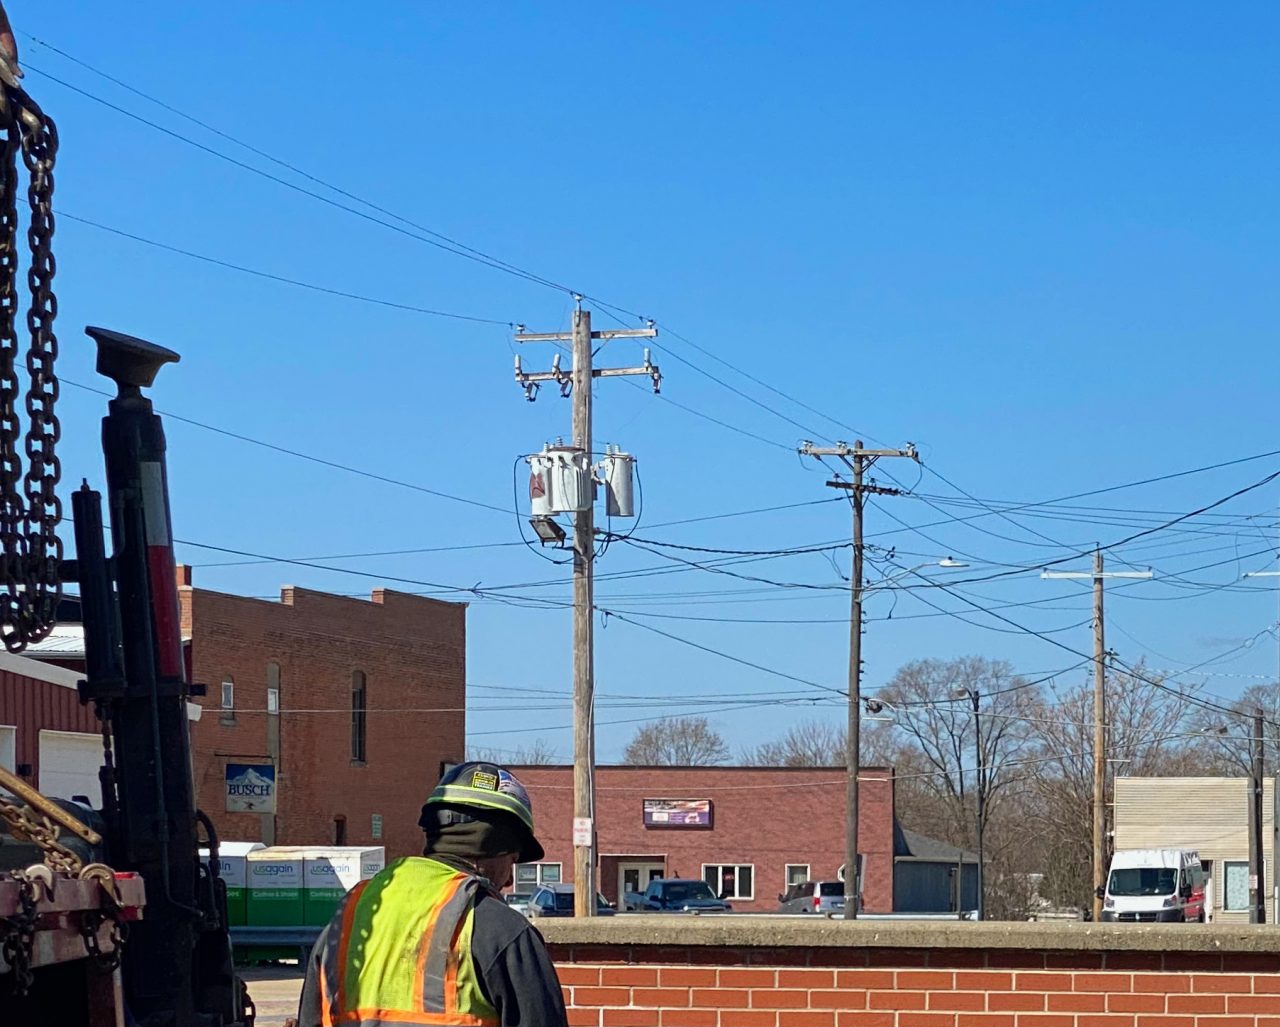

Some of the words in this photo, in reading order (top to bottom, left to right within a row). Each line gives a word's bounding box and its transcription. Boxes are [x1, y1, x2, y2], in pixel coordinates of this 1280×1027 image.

[229, 784, 271, 796] BUSCH
[253, 864, 293, 876] usagain
[311, 864, 350, 876] usagain
